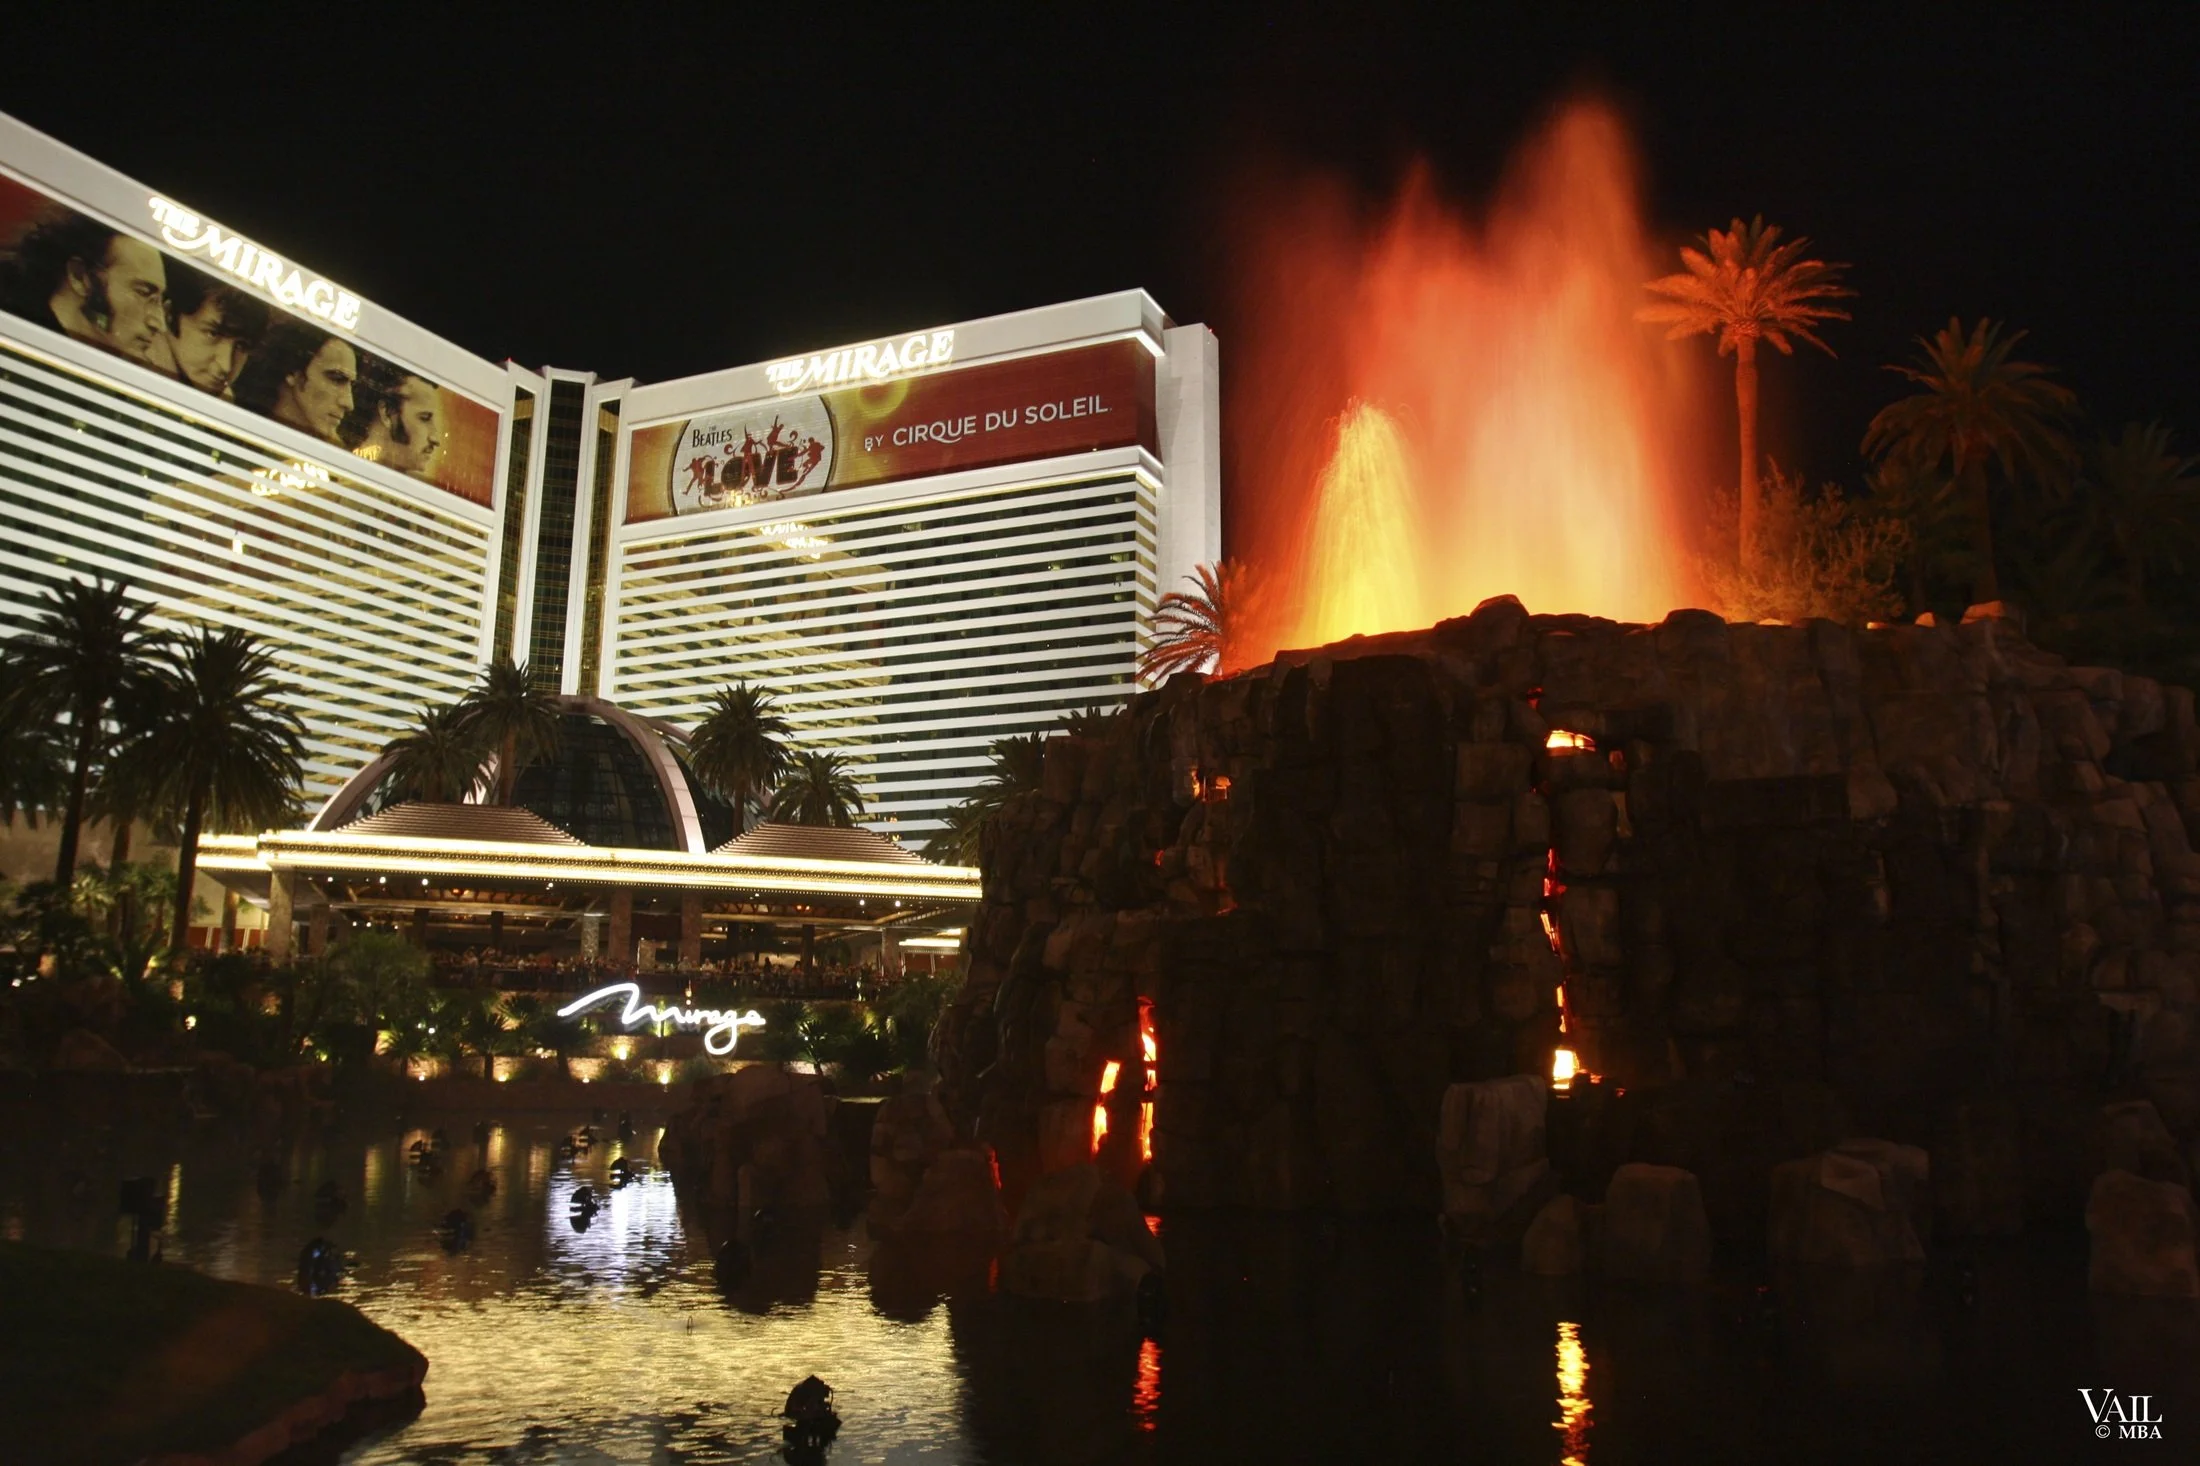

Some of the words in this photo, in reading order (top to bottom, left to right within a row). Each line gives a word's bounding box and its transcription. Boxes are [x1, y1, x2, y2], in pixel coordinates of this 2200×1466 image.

[148, 196, 200, 238] THE
[161, 224, 361, 330] MIRAGE
[765, 359, 803, 382] THE
[777, 329, 955, 393] MIRAGE
[692, 428, 733, 448] BEATLES
[864, 434, 884, 451] BY
[892, 415, 977, 445] CIRQUE
[985, 408, 1017, 432] DU
[702, 446, 799, 496] LOVE
